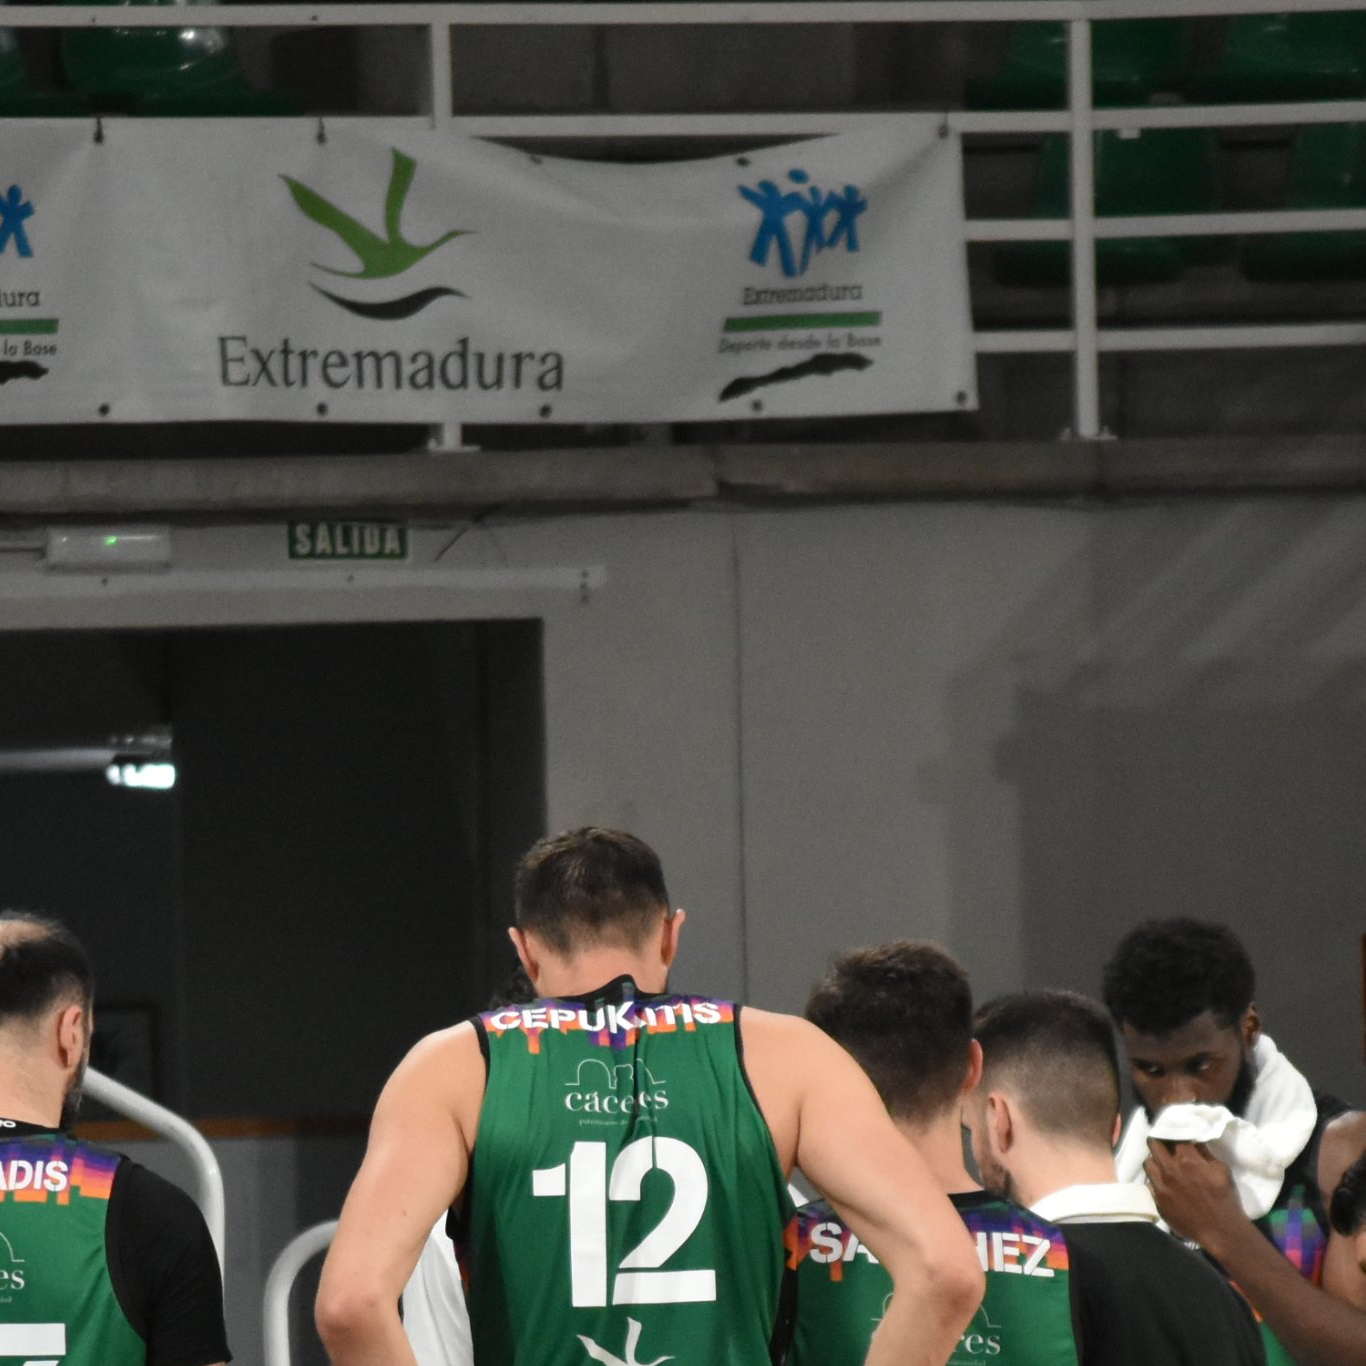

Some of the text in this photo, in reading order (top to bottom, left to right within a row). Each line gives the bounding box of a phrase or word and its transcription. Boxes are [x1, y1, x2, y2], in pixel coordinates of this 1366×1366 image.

[4, 340, 18, 357] la
[22, 339, 57, 357] Base
[218, 335, 564, 391] Extremadura
[293, 522, 403, 557] SALIDA
[532, 1136, 717, 1307] 12
